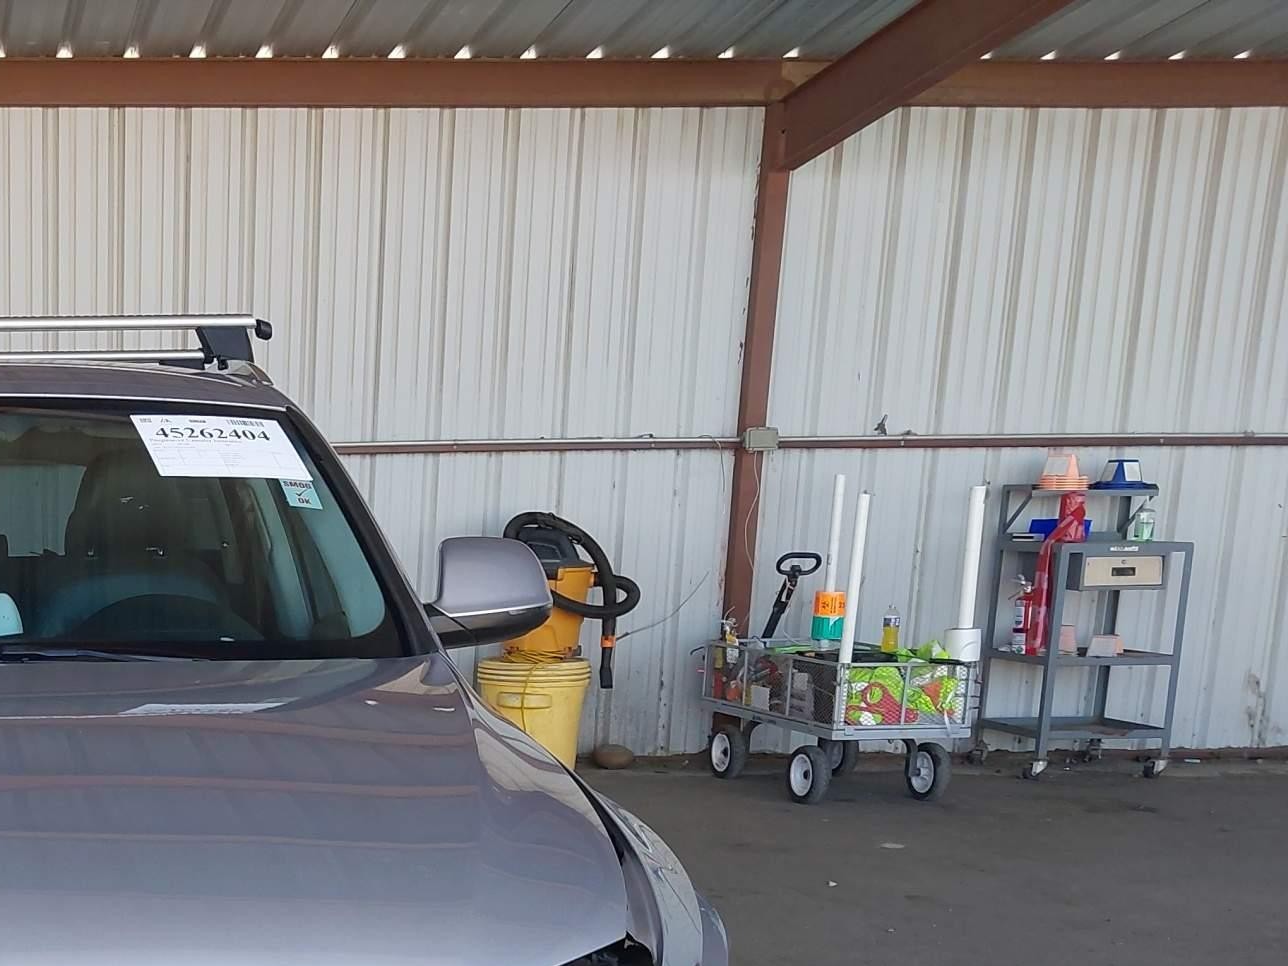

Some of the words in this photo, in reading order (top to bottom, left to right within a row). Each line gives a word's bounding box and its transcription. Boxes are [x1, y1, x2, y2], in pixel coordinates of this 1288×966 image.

[155, 427, 271, 441] 45262404
[283, 481, 312, 489] SMOG
[297, 497, 312, 505] OK
